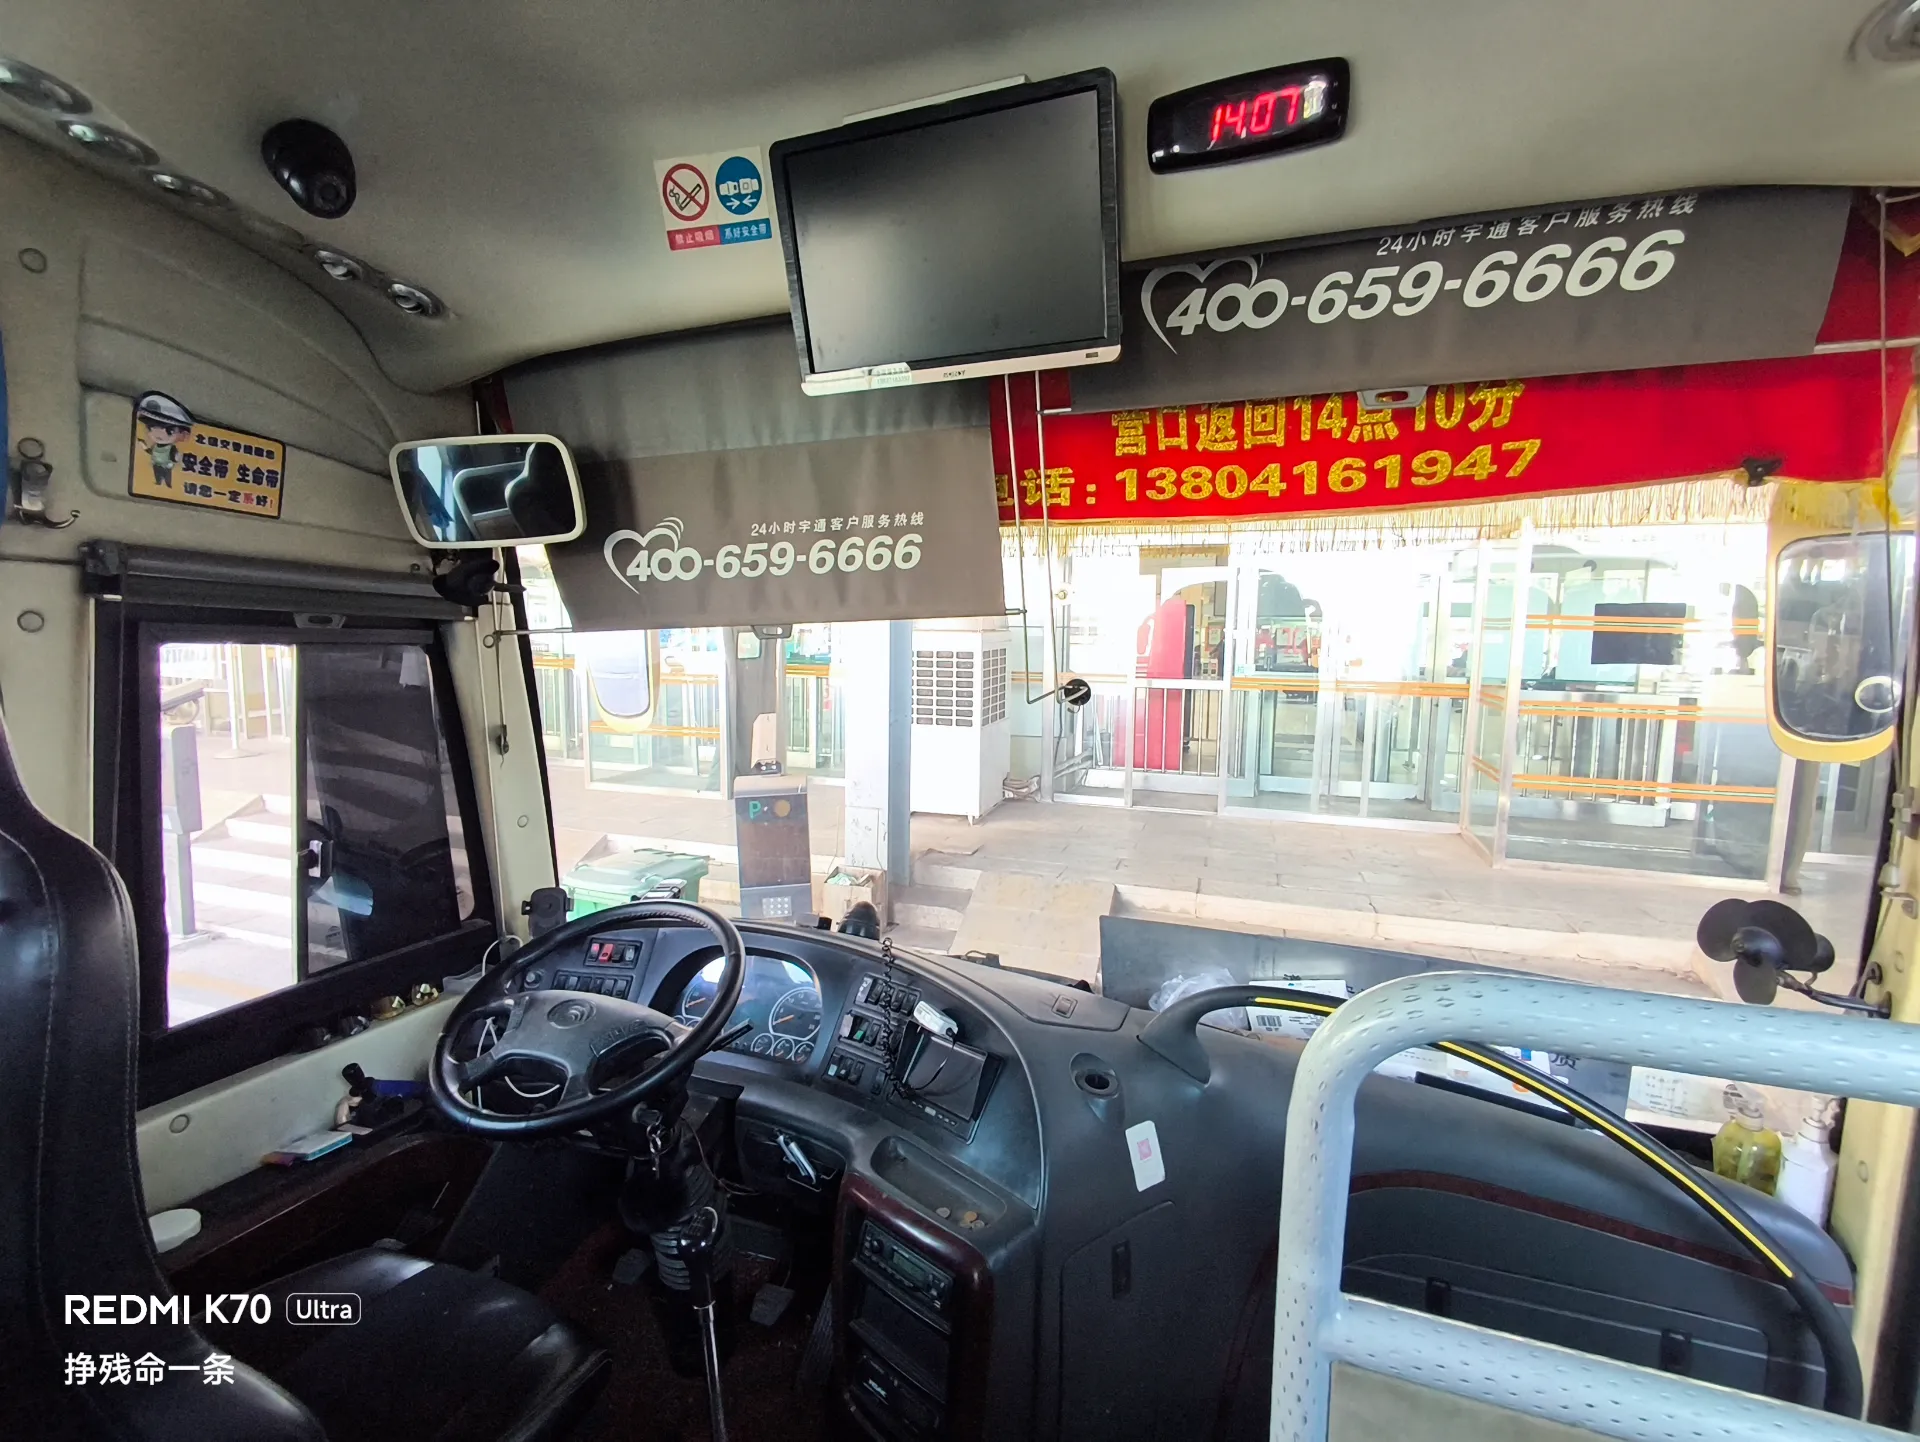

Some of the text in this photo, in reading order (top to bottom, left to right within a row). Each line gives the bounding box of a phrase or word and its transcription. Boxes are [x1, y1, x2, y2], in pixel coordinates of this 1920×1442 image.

[1166, 229, 1685, 336] 400-659-6666
[750, 511, 924, 537] 24小时宇通客户服务热线
[626, 533, 923, 583] 400-659-6666
